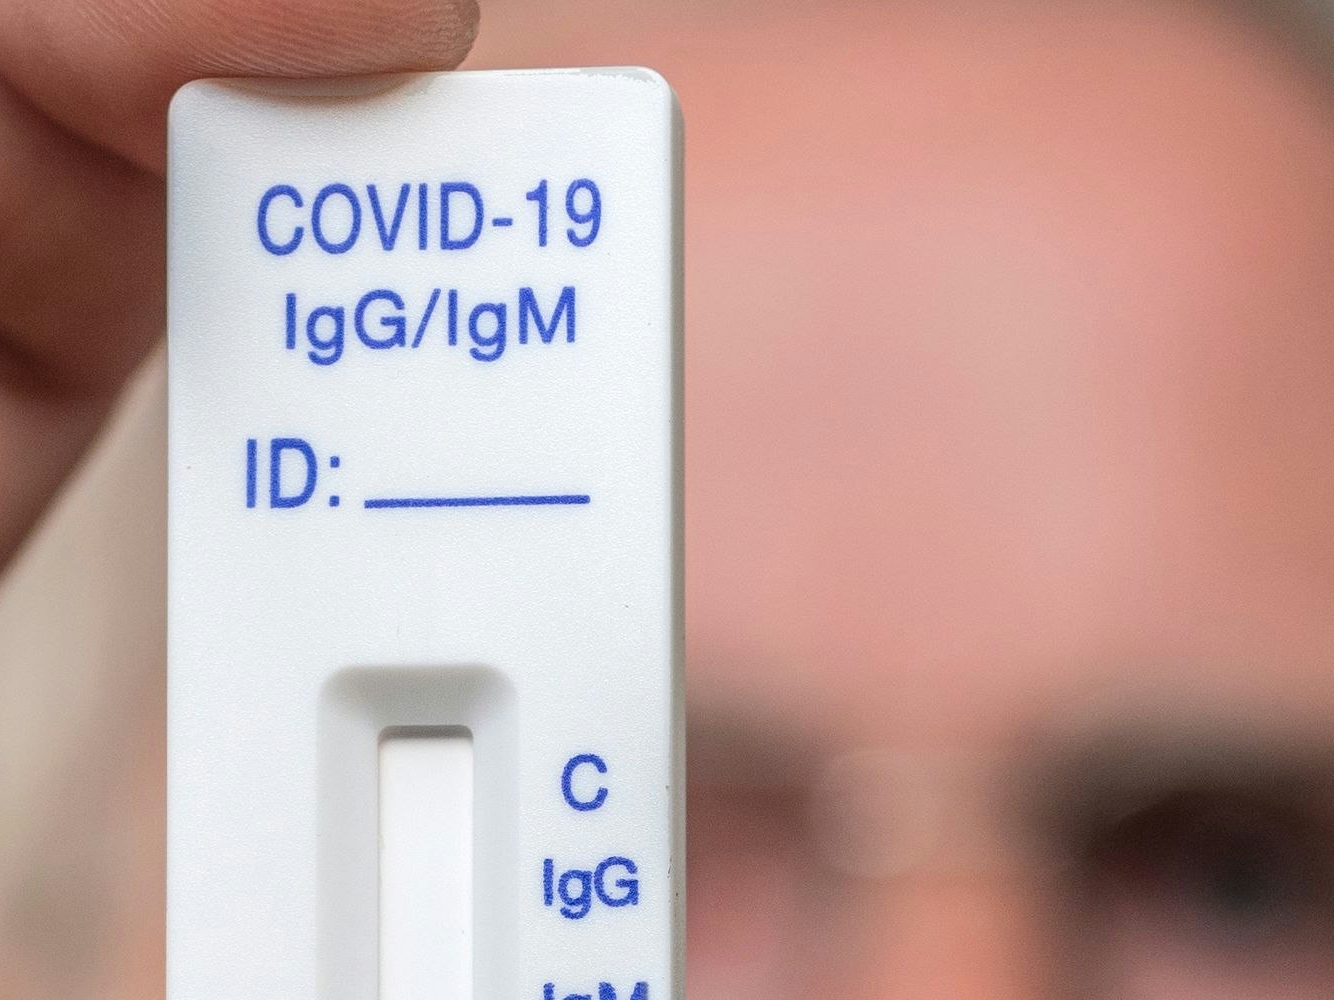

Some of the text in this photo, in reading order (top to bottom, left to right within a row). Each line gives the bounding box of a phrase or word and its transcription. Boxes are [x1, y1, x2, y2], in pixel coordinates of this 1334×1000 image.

[255, 177, 604, 257] COVID-19
[283, 285, 578, 367] IgG/IgM
[243, 436, 343, 511] ID:
[559, 752, 610, 813] C
[541, 854, 641, 921] IgG
